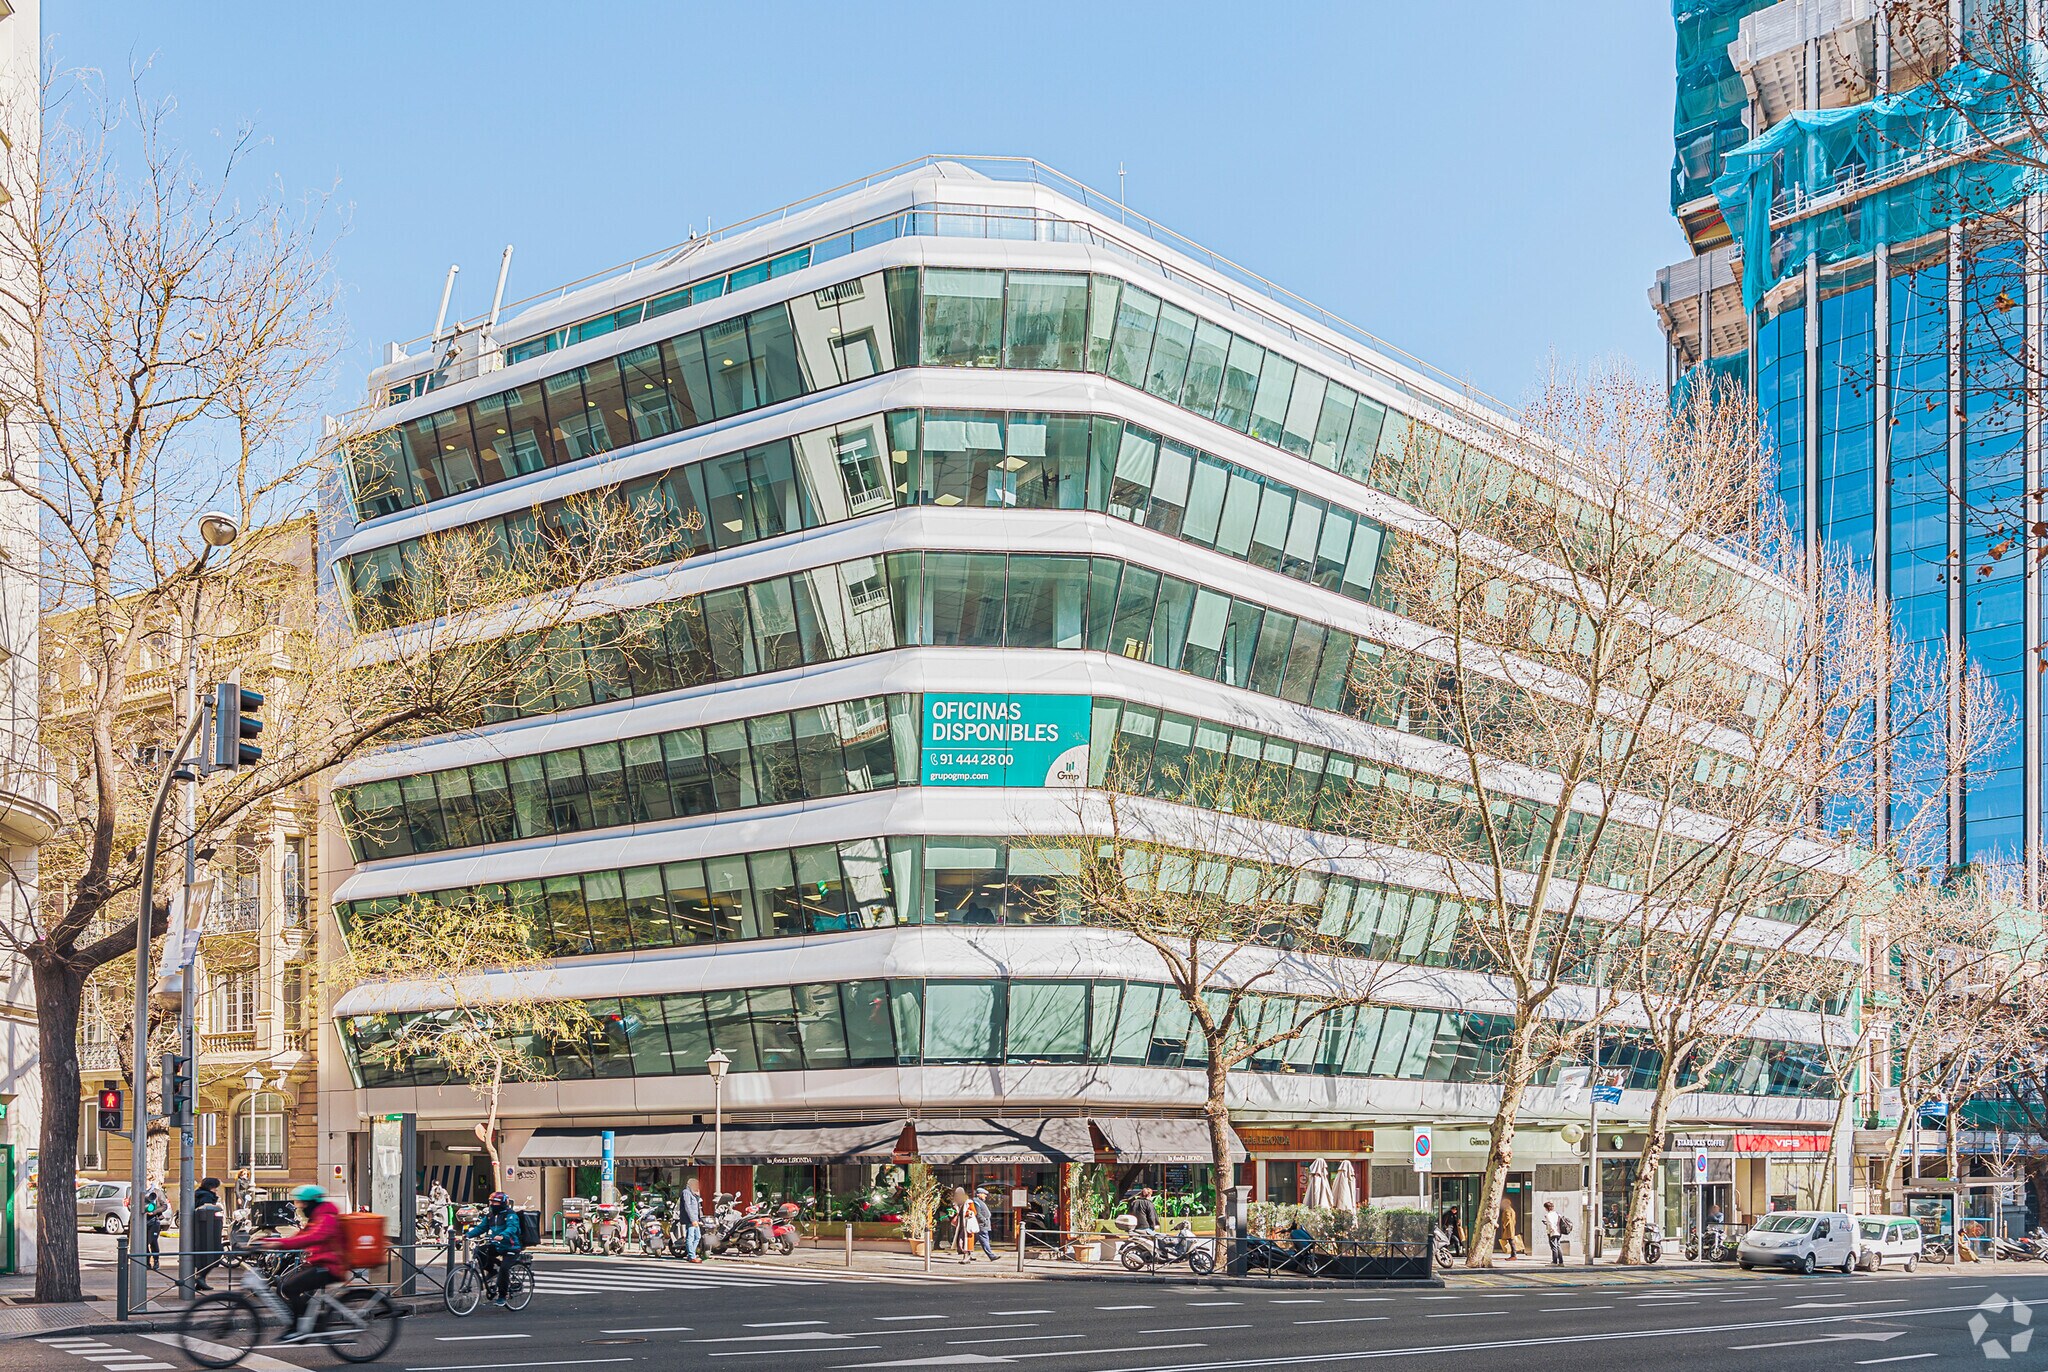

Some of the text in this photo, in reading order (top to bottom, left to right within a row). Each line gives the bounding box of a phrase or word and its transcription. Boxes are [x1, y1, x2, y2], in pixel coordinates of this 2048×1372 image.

[932, 701, 1021, 720] OFICINAS
[932, 723, 1058, 742] DISPONIBLES
[939, 753, 953, 765] 91
[955, 753, 979, 766] 444
[930, 772, 989, 782] grupogmp.com
[1057, 770, 1080, 782] Gmp
[1677, 1139, 1725, 1147] STARBUCKS COFFEE
[1774, 1139, 1799, 1147] VIPS
[772, 1157, 788, 1165] fonda
